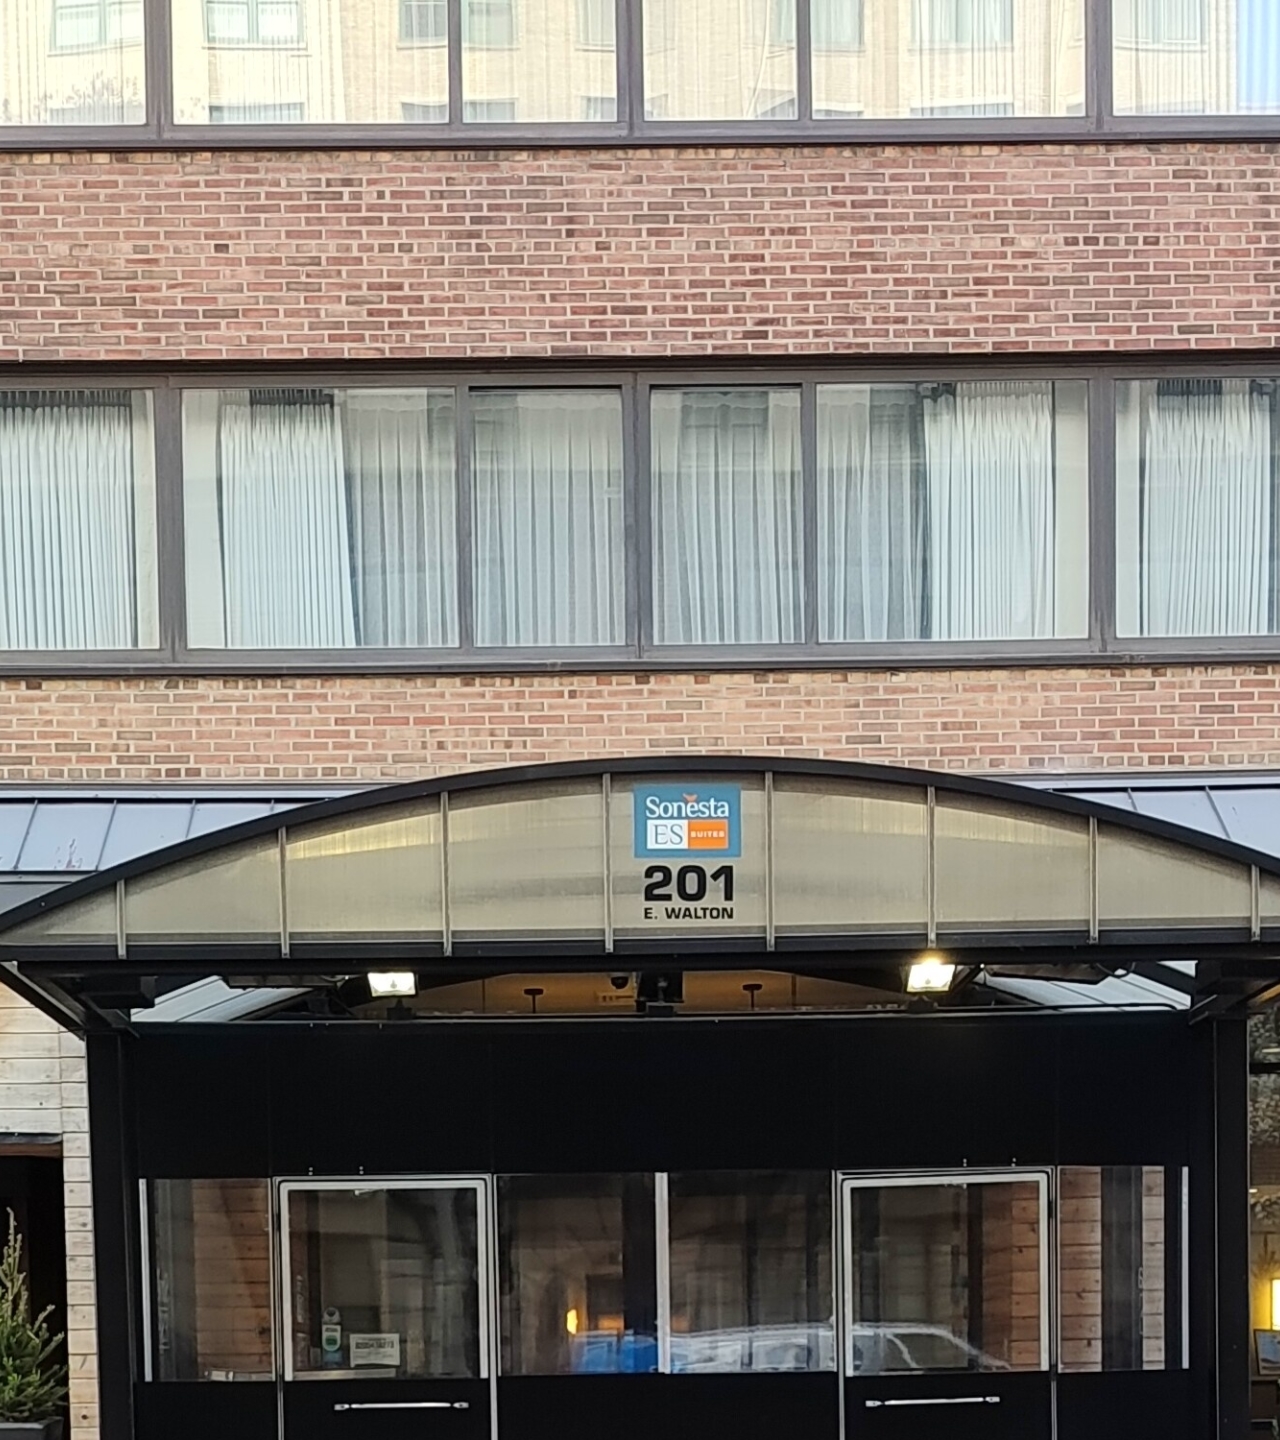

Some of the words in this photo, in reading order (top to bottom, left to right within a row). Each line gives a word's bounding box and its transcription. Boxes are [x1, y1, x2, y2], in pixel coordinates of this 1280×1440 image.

[645, 796, 729, 818] Sonesta
[654, 824, 683, 845] ES
[690, 830, 725, 838] SUITES
[644, 865, 734, 902] 201
[644, 907, 658, 920] E.
[664, 907, 734, 920] WALTON
